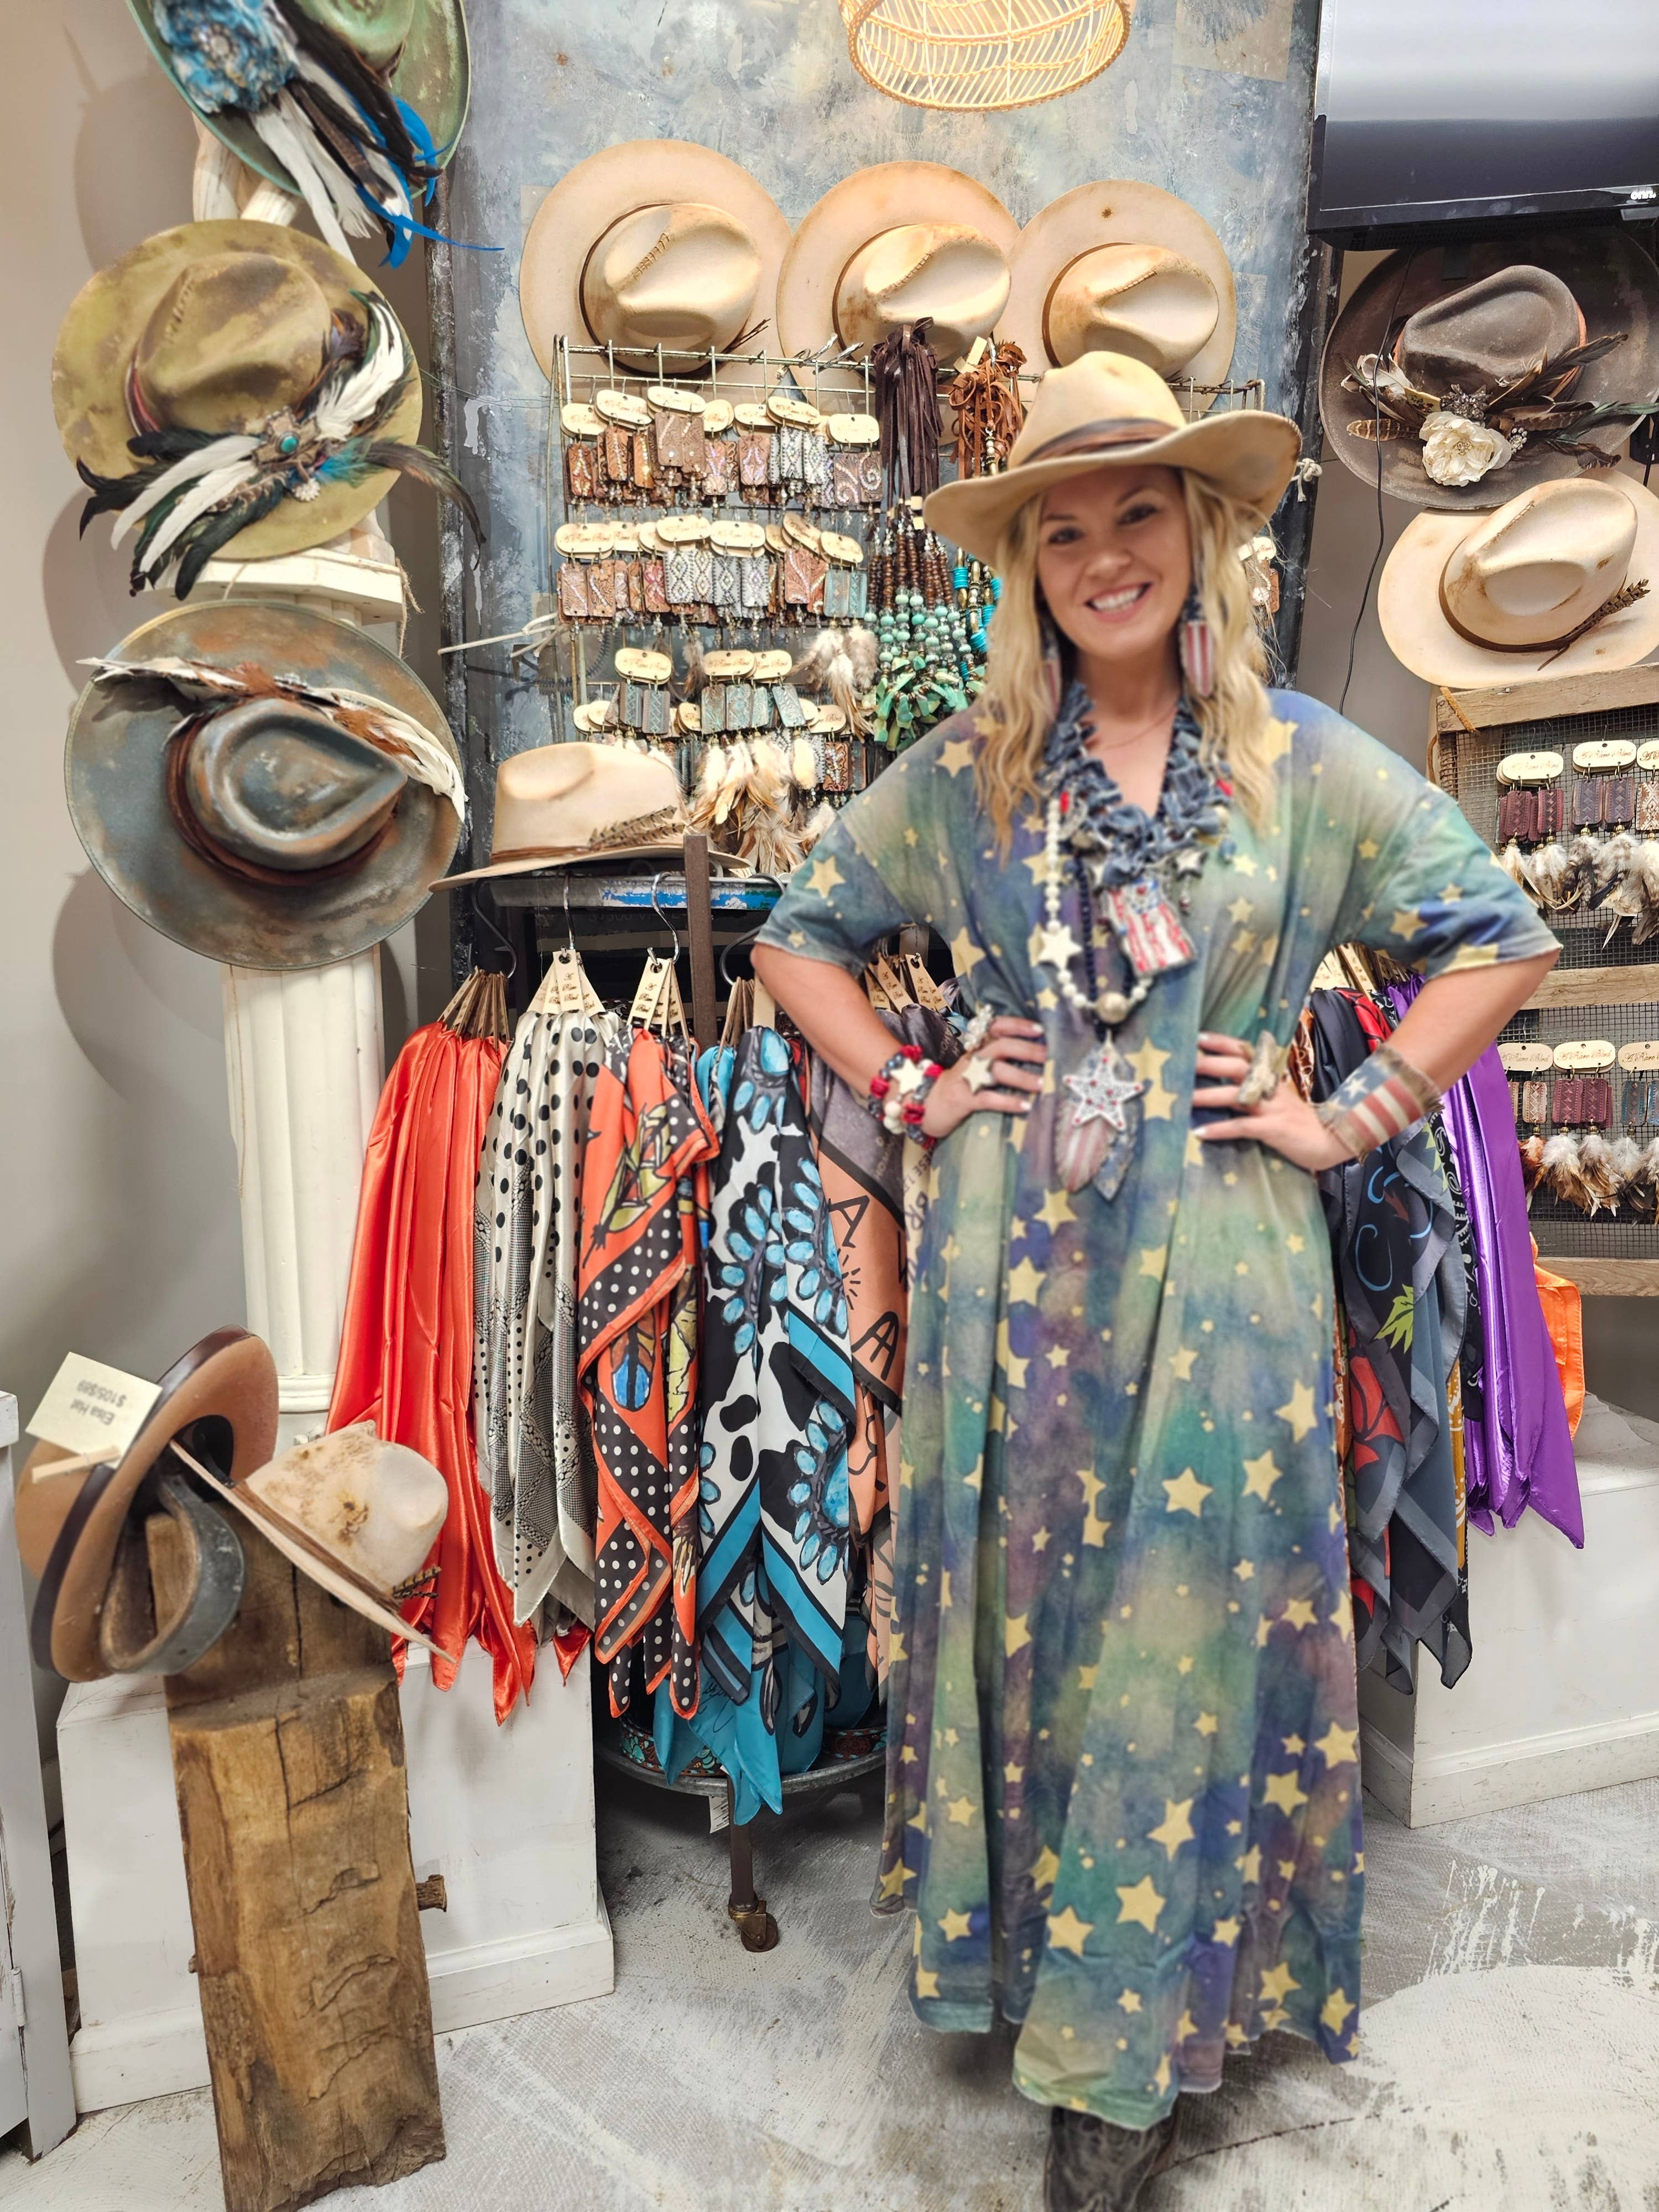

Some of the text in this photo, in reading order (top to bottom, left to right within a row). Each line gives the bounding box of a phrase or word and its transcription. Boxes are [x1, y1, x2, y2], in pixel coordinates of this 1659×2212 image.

[1630, 189, 1656, 200] onn.
[1508, 1052, 1530, 1062] Rare
[1530, 1052, 1551, 1062] Bird
[1569, 1050, 1590, 1061] Rare
[1591, 1049, 1613, 1058] Bird
[1634, 1051, 1655, 1062] Rare
